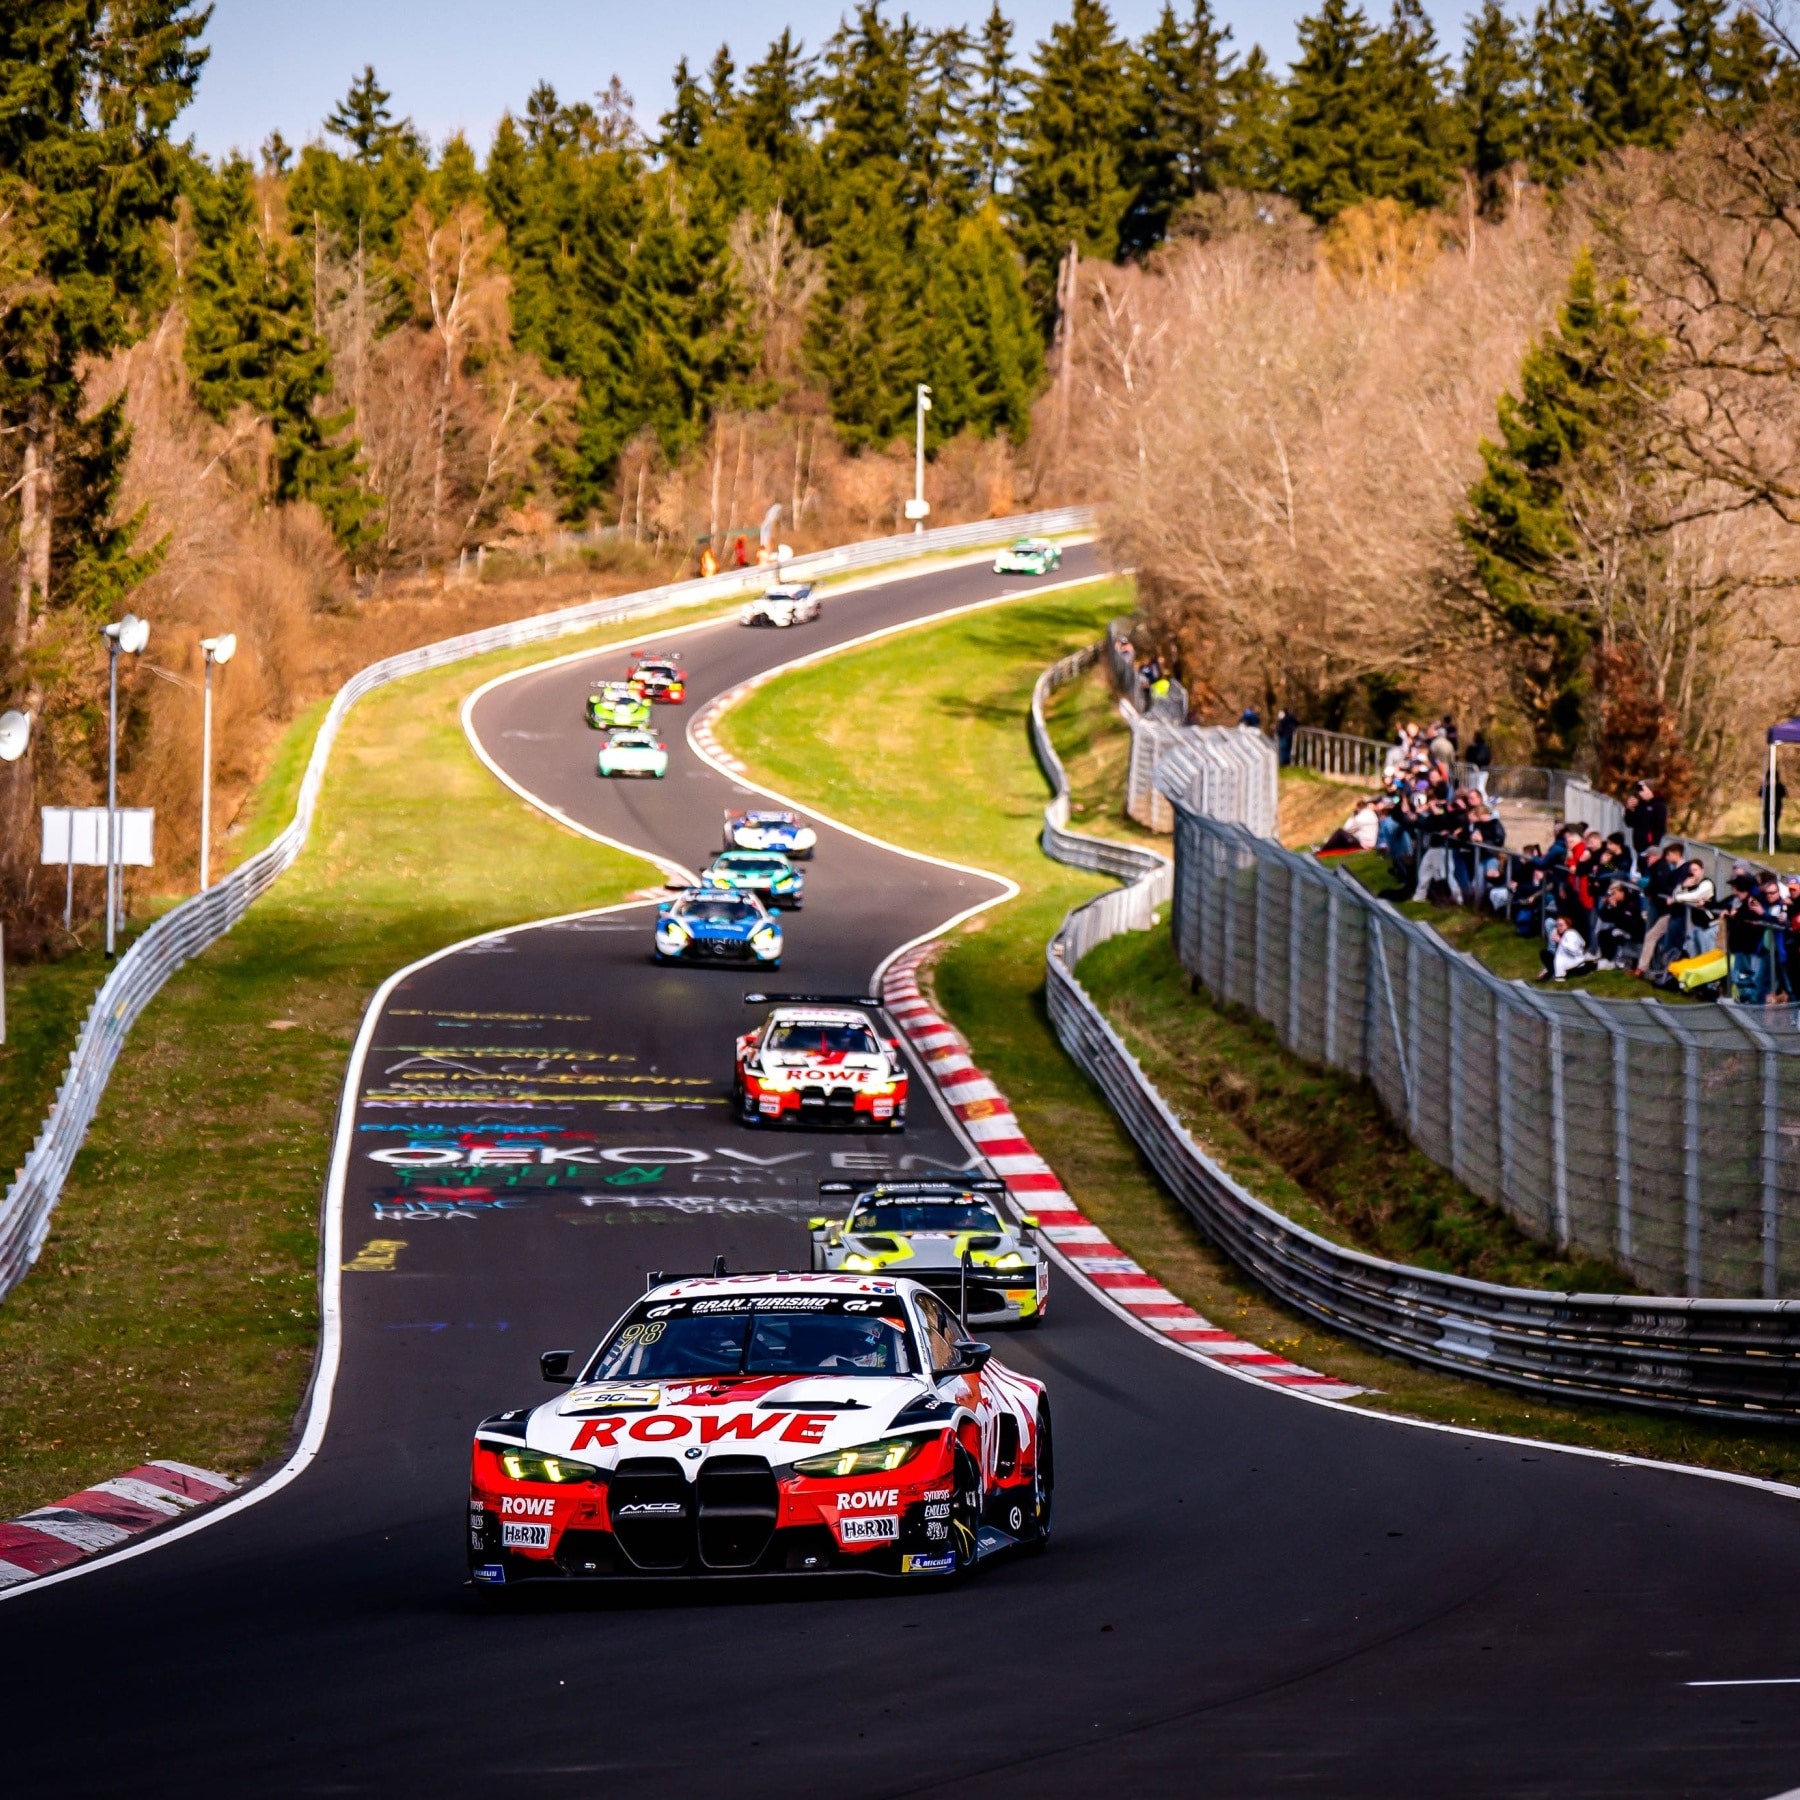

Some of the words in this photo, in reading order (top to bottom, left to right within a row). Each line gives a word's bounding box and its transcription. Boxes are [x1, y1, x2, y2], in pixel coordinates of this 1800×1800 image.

[786, 1070, 871, 1082] ROWE
[693, 1299, 744, 1311] GRAN
[621, 1321, 667, 1349] 98
[570, 1412, 837, 1451] ROWE
[501, 1496, 555, 1516] ROWE
[836, 1489, 899, 1511] ROWE
[505, 1525, 531, 1544] H&R
[845, 1521, 877, 1538] H&R
